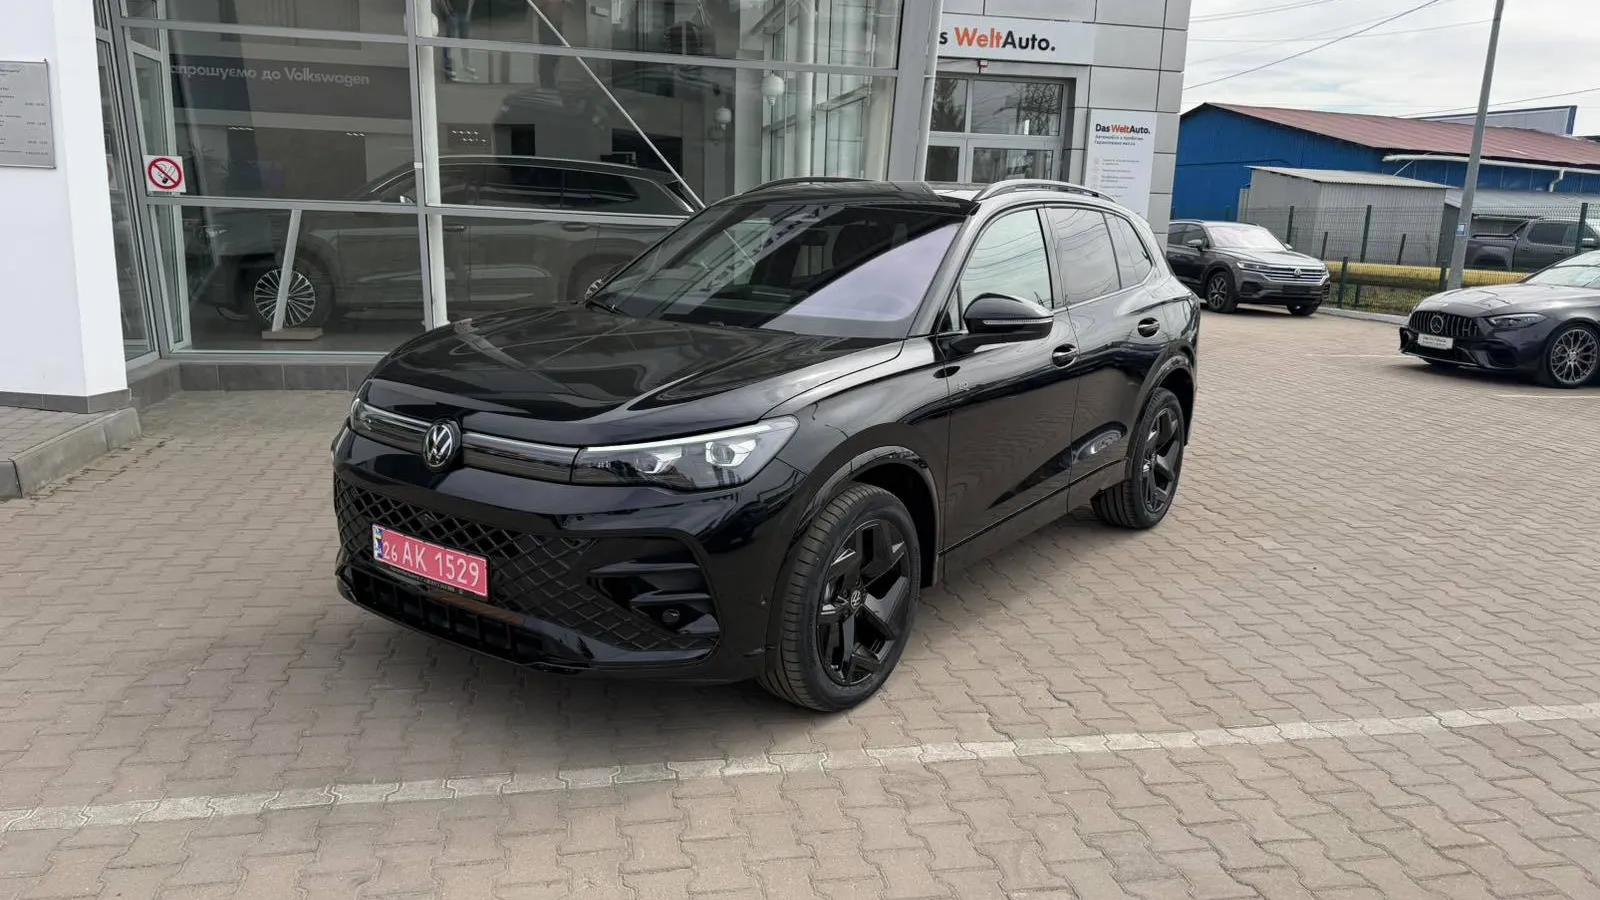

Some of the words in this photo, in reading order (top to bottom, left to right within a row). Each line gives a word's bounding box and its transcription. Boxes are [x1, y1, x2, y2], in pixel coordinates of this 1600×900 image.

[954, 27, 1056, 51] WeltAuto.
[171, 64, 257, 79] апрошуємо
[261, 68, 281, 81] до
[284, 67, 370, 87] Volkswagen
[1095, 123, 1110, 133] Das
[1111, 124, 1151, 135] WeltAuto.
[383, 541, 398, 562] 26
[402, 541, 427, 572] AK
[435, 552, 479, 587] 1529
